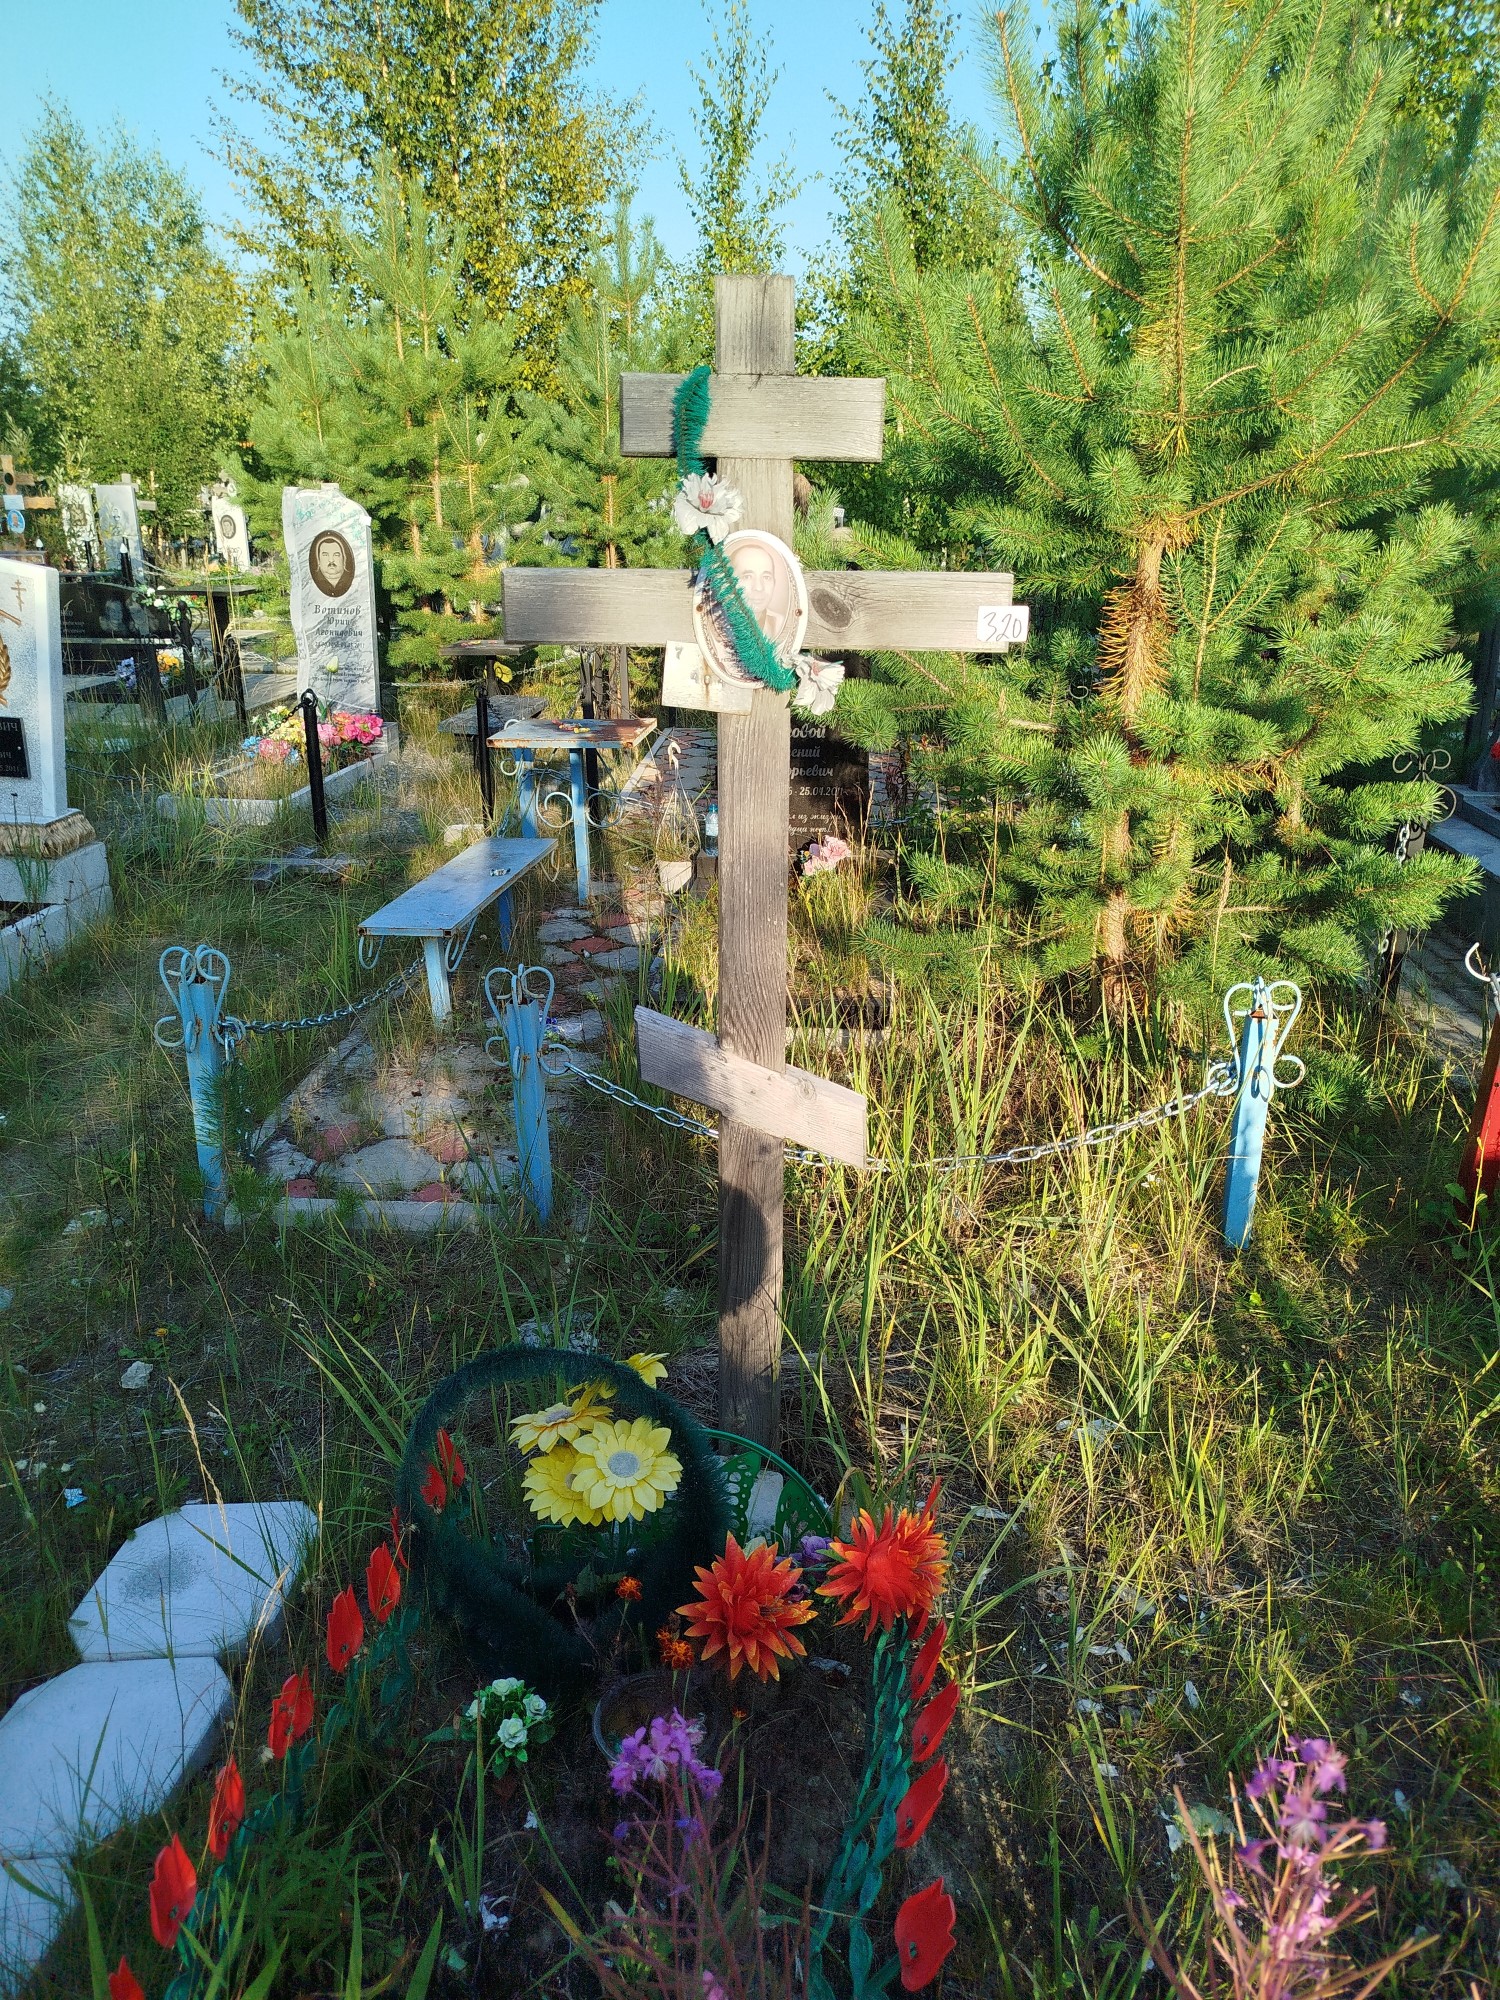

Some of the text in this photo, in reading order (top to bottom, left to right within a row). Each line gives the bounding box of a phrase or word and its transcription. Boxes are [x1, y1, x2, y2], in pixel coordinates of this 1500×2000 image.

[314, 604, 362, 615] Вотинов
[983, 611, 1022, 642] 320
[790, 723, 826, 739] овой
